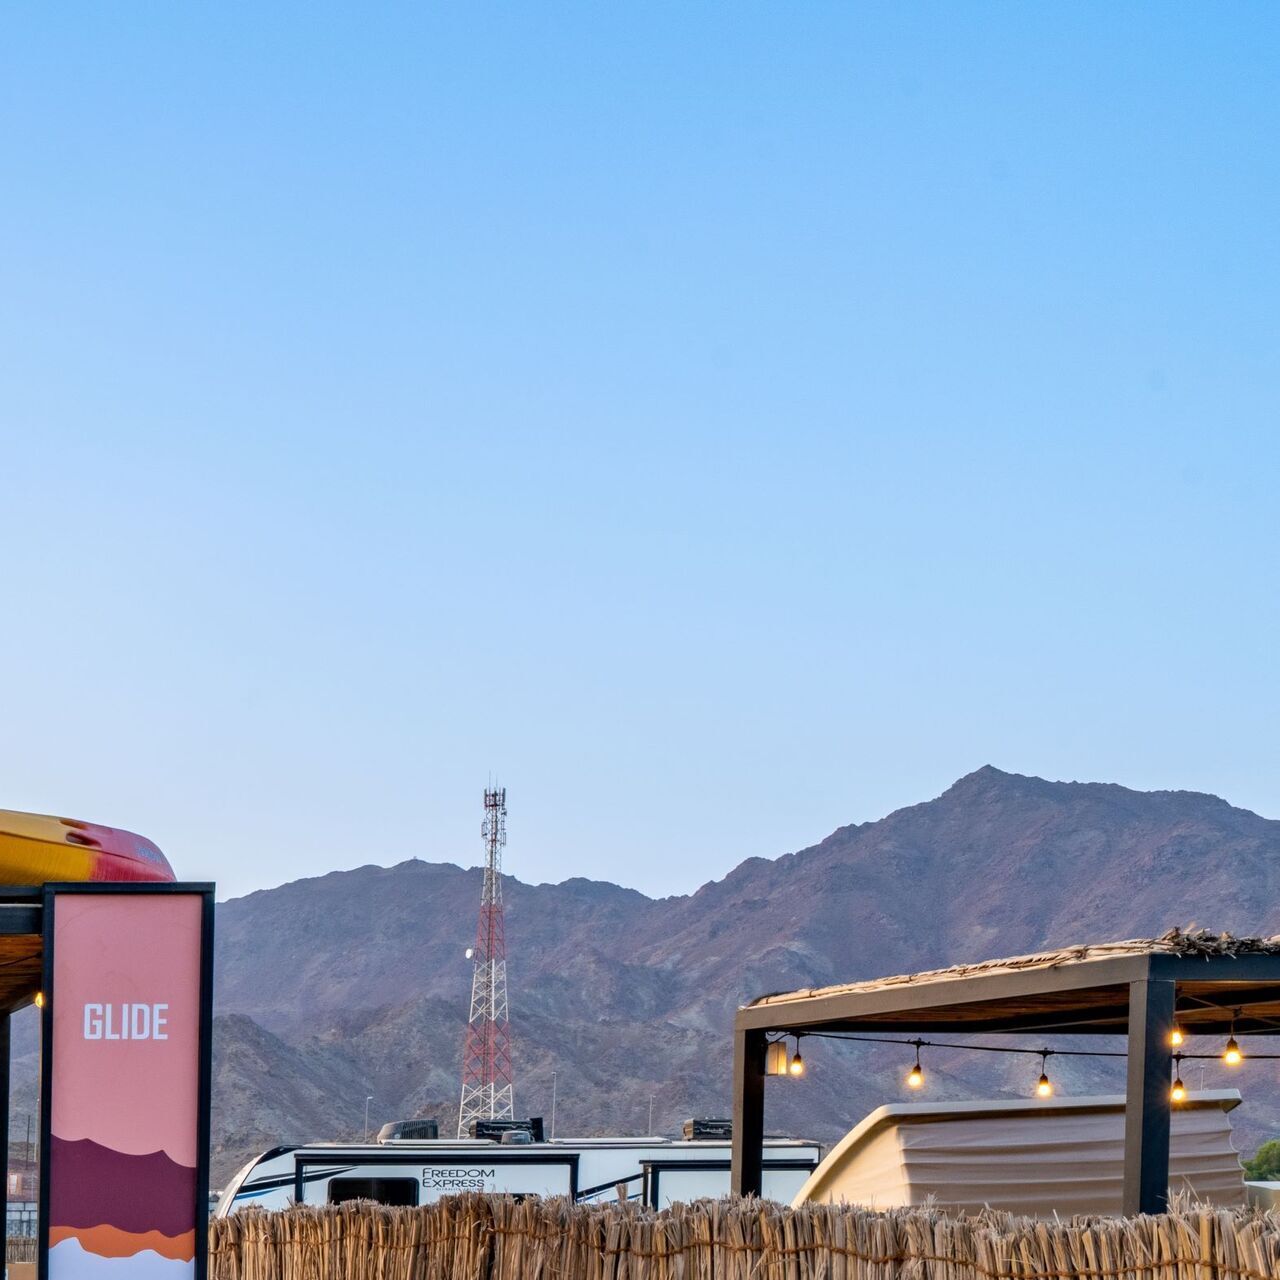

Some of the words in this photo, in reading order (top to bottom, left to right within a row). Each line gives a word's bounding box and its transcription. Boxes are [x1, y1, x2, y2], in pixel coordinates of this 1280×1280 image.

[84, 1003, 169, 1040] GLIDE
[422, 1168, 495, 1178] FREEDOM
[422, 1178, 485, 1188] EXPRESS
